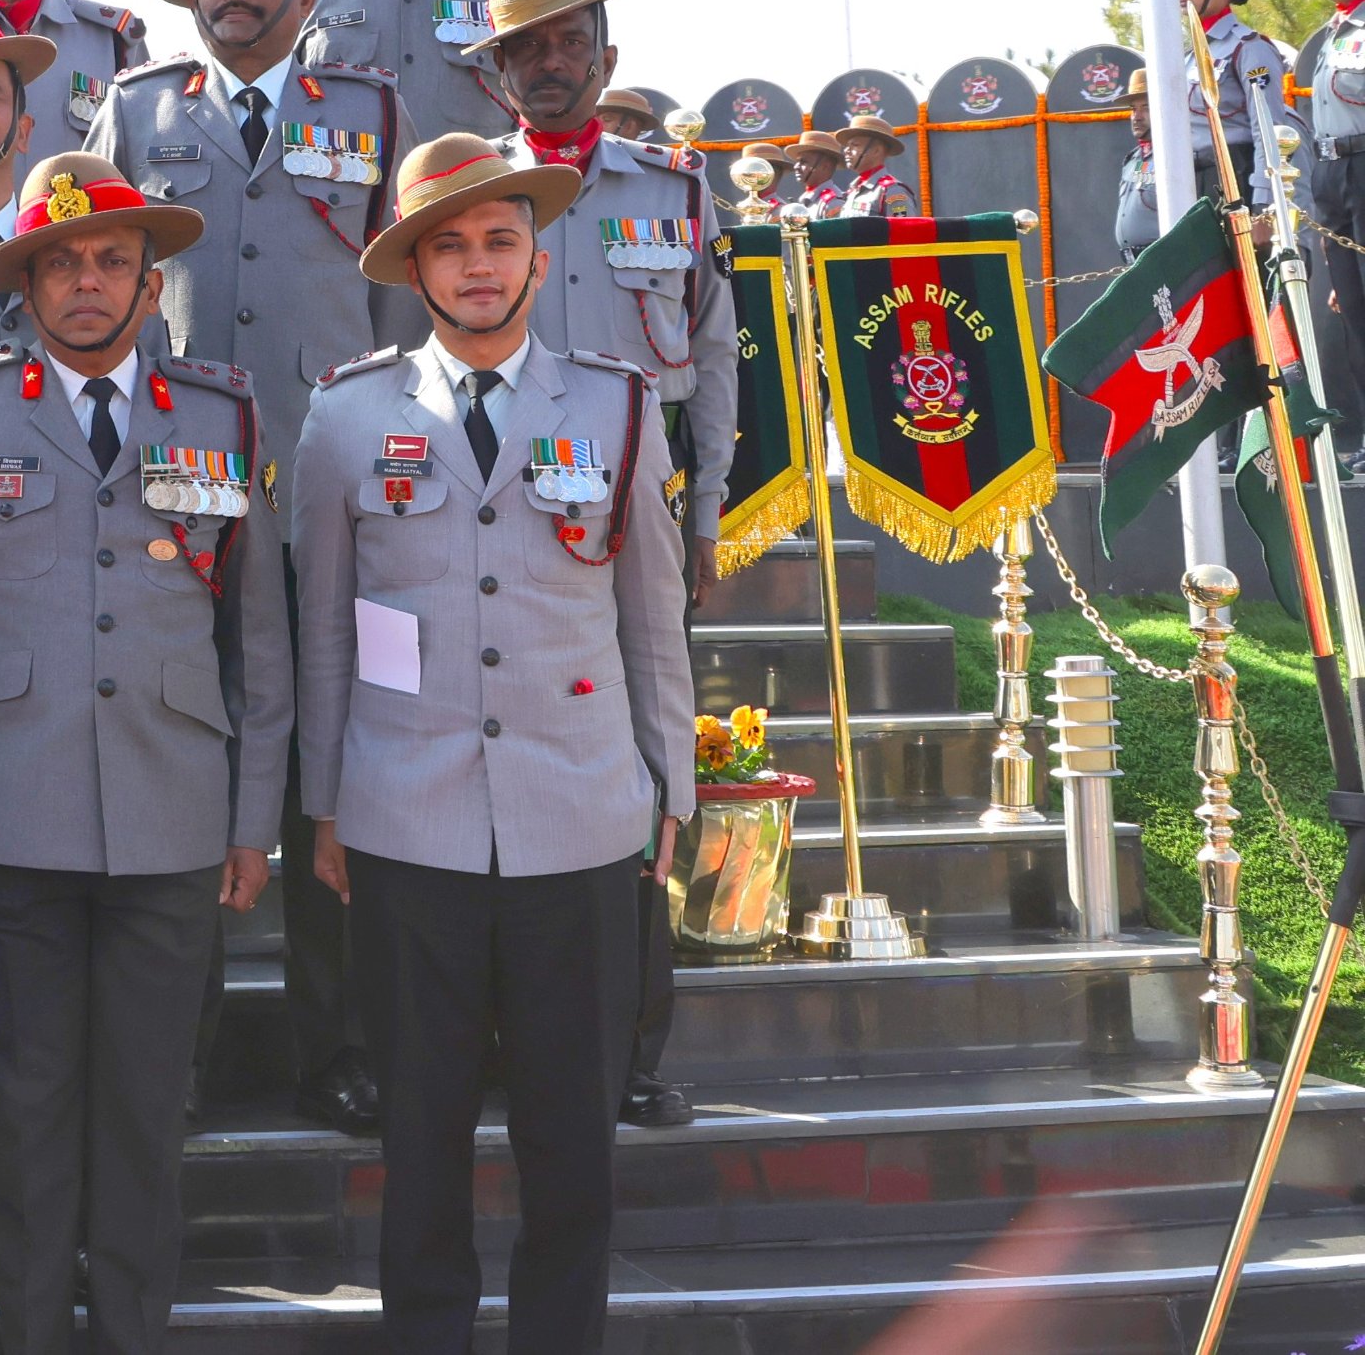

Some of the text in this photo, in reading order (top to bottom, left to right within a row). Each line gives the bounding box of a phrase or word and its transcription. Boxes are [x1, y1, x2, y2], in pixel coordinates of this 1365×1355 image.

[853, 283, 994, 350] ASSAM RIFLES
[1159, 366, 1216, 423] ASSAM RIFLES
